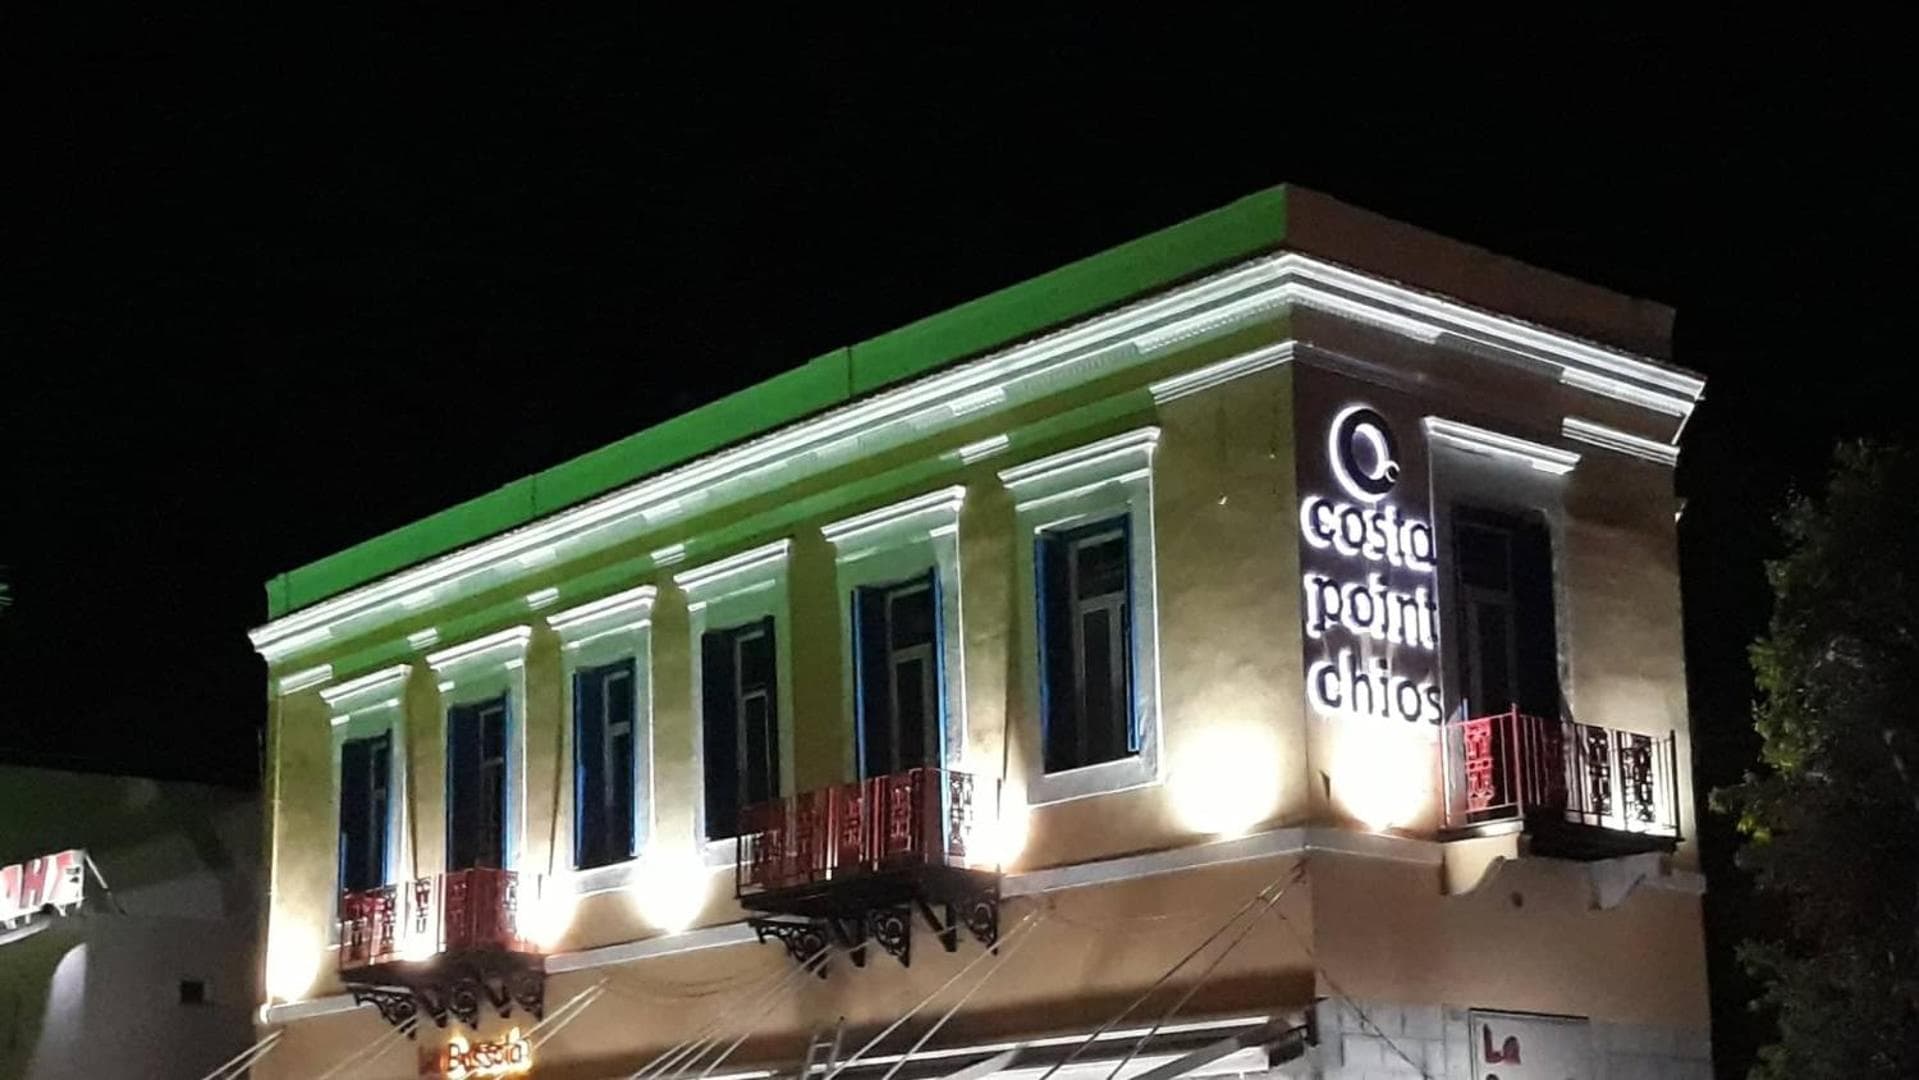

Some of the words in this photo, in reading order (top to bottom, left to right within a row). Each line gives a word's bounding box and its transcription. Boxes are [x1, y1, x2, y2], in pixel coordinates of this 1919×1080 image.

[1302, 497, 1437, 571] costa
[1304, 572, 1438, 649] point
[1308, 650, 1443, 725] chios
